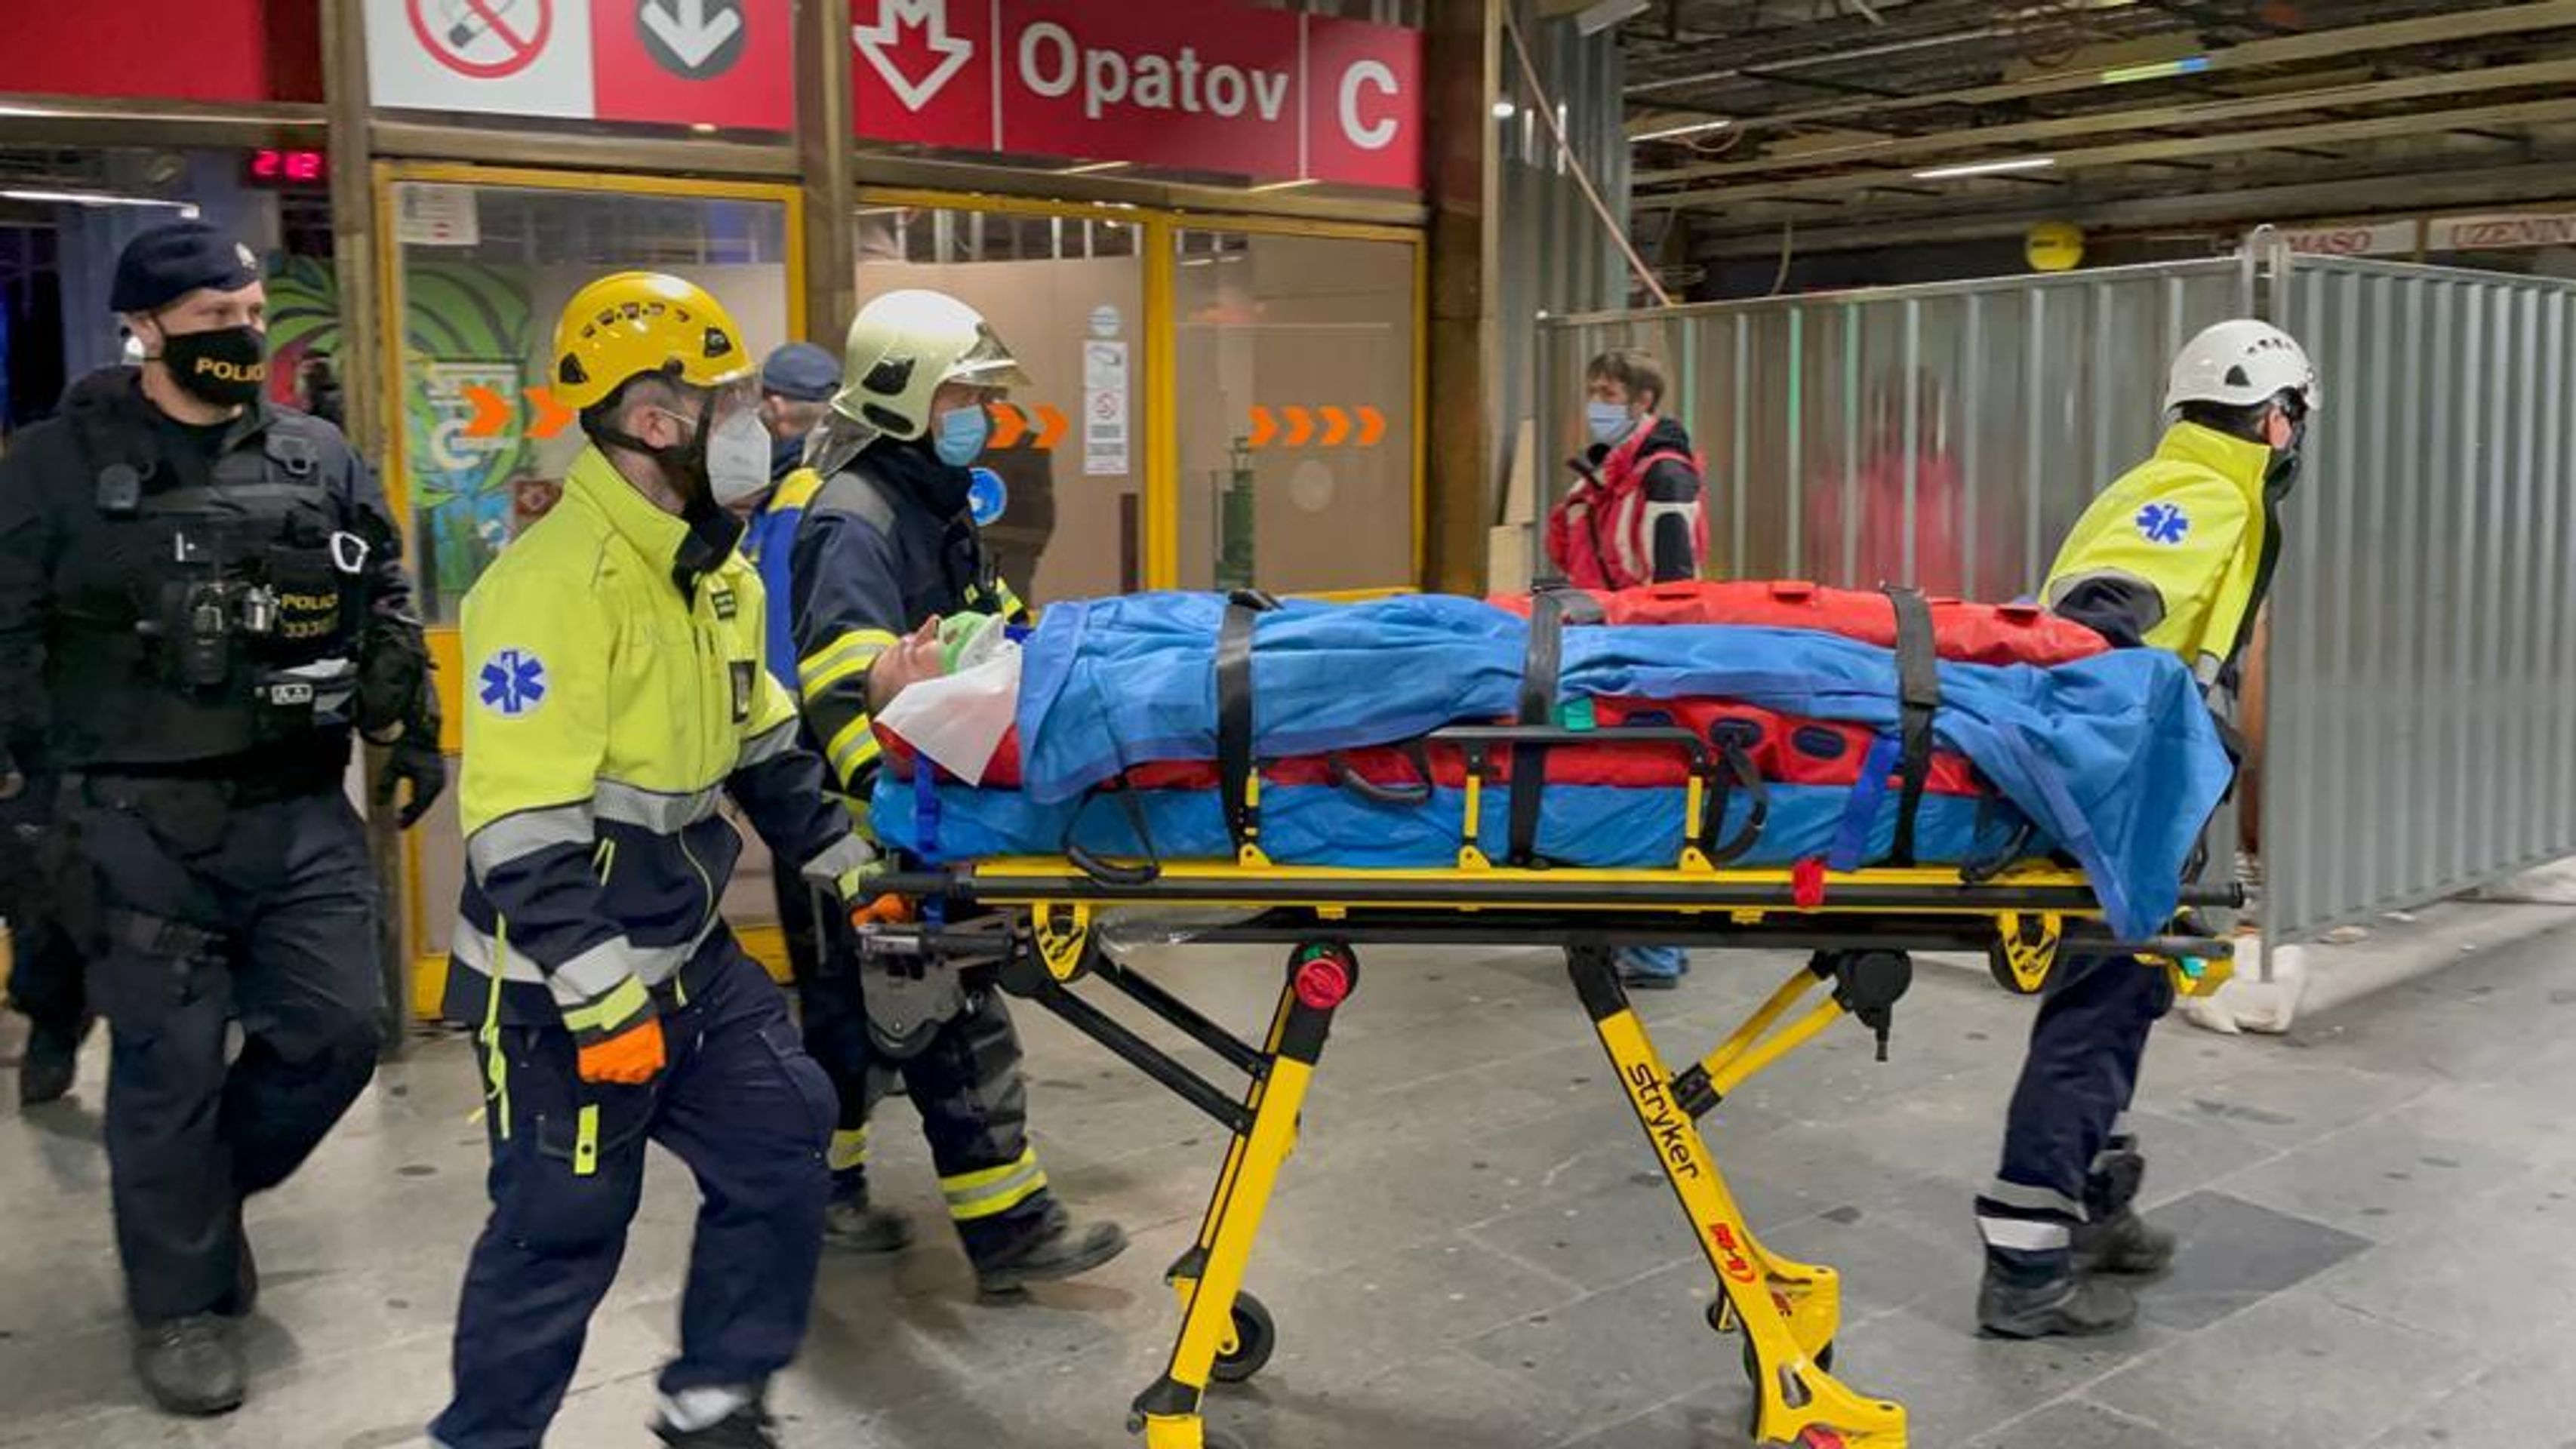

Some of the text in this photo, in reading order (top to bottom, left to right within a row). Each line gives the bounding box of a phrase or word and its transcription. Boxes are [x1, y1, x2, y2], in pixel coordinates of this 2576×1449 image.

[1018, 21, 1289, 122] Opatov
[1338, 59, 1399, 149] C
[2287, 229, 2372, 254] MASO
[1627, 1062, 1698, 1180] stryker
